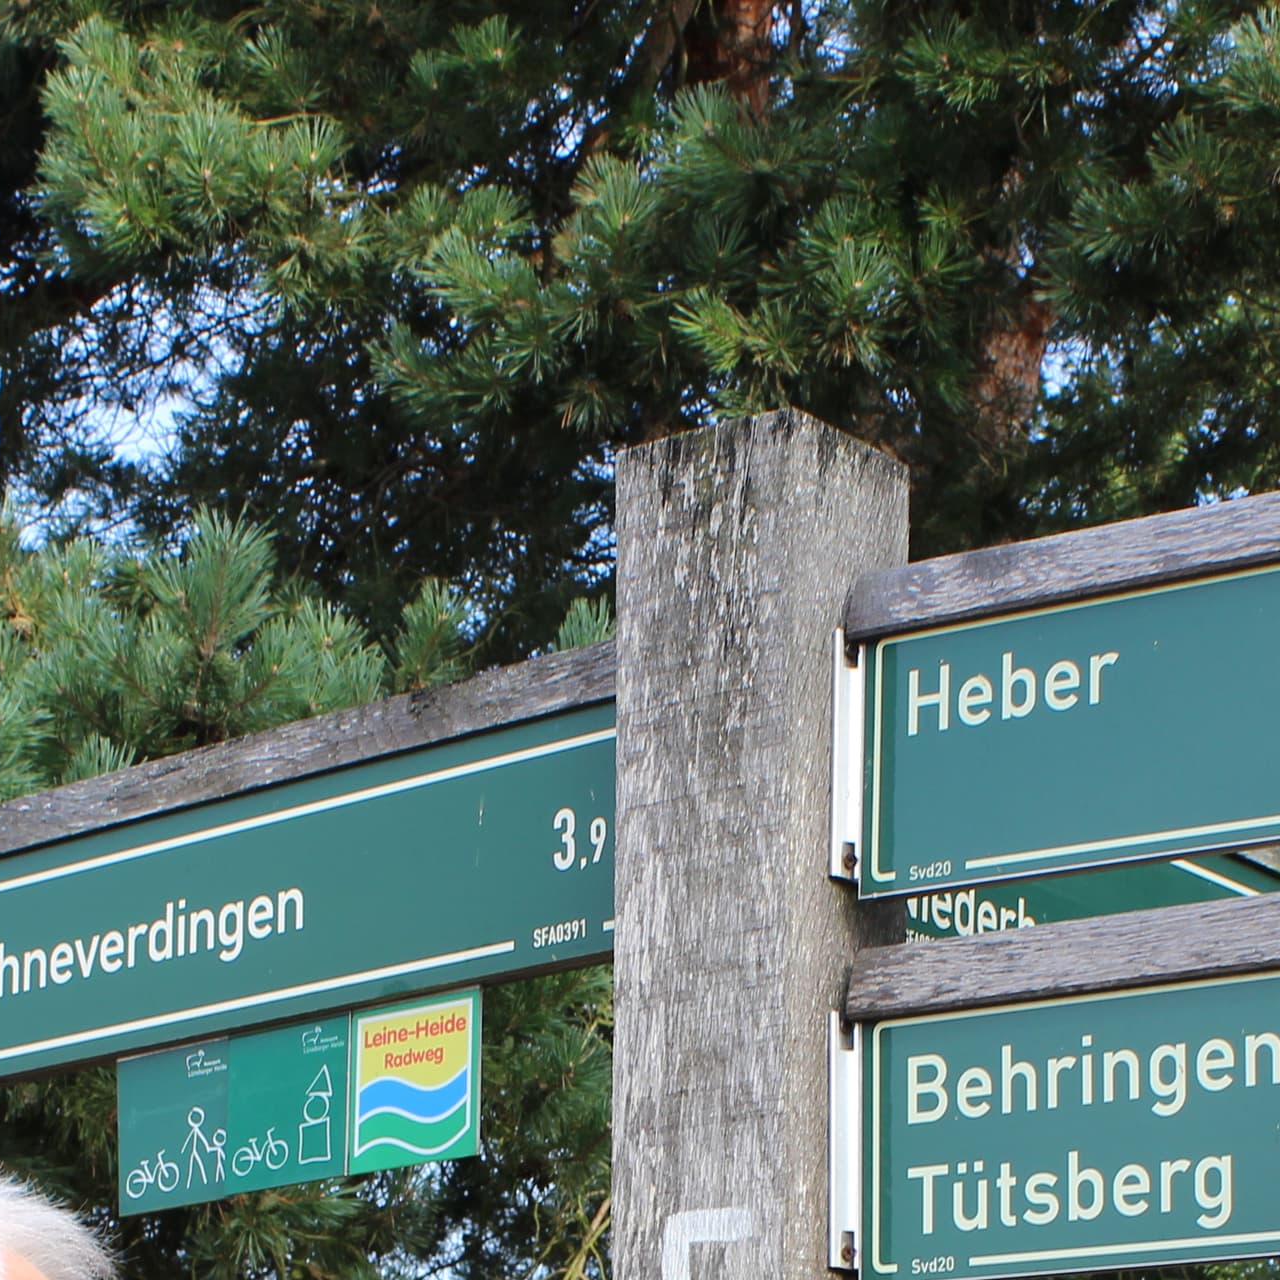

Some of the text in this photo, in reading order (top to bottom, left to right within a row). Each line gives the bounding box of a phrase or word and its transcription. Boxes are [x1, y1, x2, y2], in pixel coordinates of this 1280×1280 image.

[907, 651, 1120, 737] Heber
[552, 806, 608, 872] 3,9
[909, 859, 952, 881] Svd20
[533, 917, 587, 949] SFA0391
[363, 1012, 468, 1049] Leine-Heide
[383, 1046, 445, 1070] Radweg
[906, 1150, 1234, 1235] Tütsberg
[911, 1255, 955, 1275] Svd20
